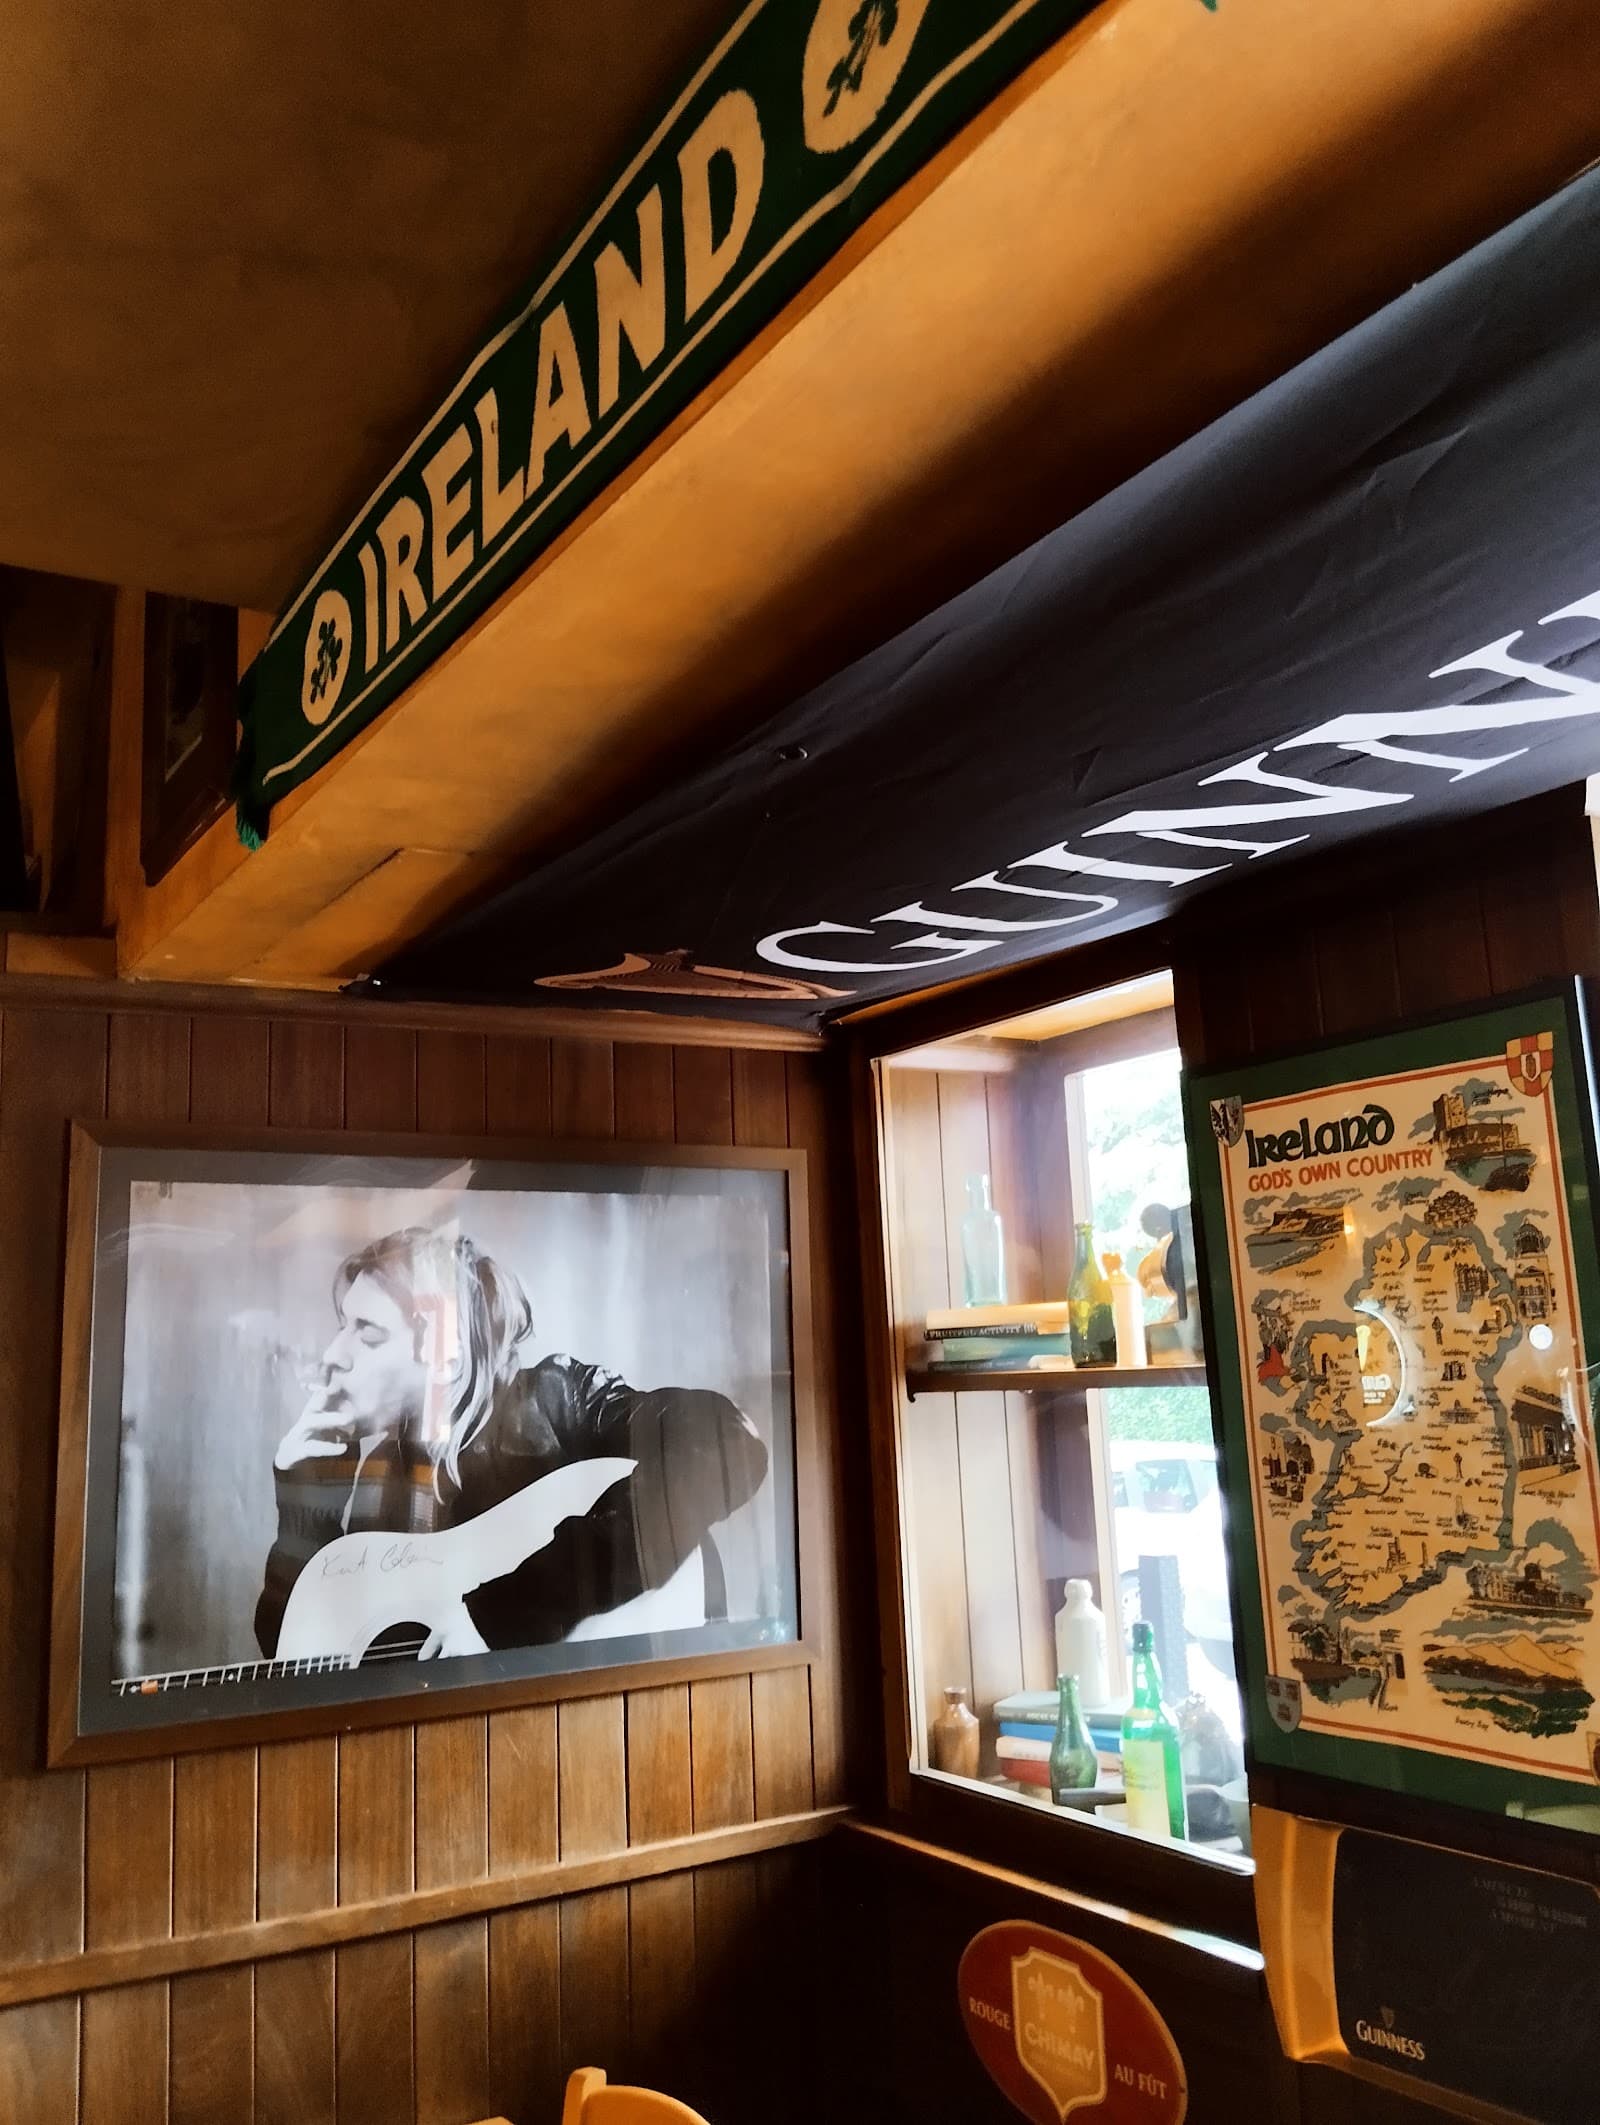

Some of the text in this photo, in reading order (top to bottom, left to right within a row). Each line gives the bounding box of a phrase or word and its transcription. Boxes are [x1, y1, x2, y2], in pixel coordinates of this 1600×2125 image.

[358, 90, 765, 674] IRELAND
[757, 590, 1600, 974] GUINN
[1244, 1104, 1395, 1168] Ireland
[1248, 1148, 1434, 1192] GOD'S OWN COUNTRY
[969, 1997, 1011, 2030] ROUGE
[1024, 2022, 1095, 2070] CHIMAY
[1356, 2019, 1425, 2061] GUINNESS
[1114, 2063, 1134, 2086] AU
[1138, 2073, 1167, 2099] FÛT
